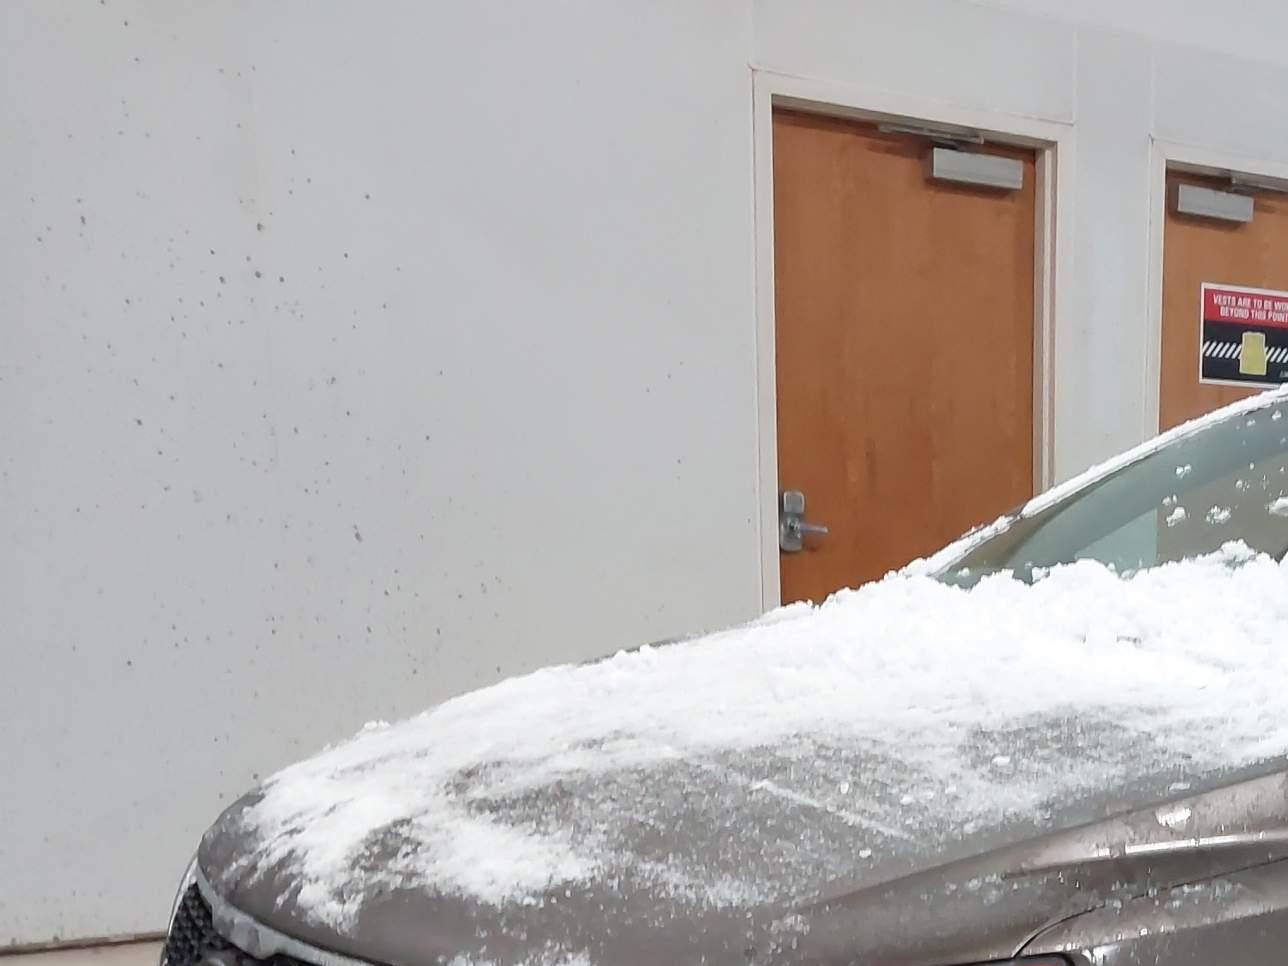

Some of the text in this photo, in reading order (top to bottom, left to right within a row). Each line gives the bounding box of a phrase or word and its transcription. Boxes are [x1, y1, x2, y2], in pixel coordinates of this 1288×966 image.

[1213, 294, 1236, 306] VESTS
[1237, 297, 1251, 308] ARE
[1253, 299, 1263, 309] TO
[1264, 300, 1273, 310] BE
[1220, 306, 1288, 323] BEYOND THIS POINT
